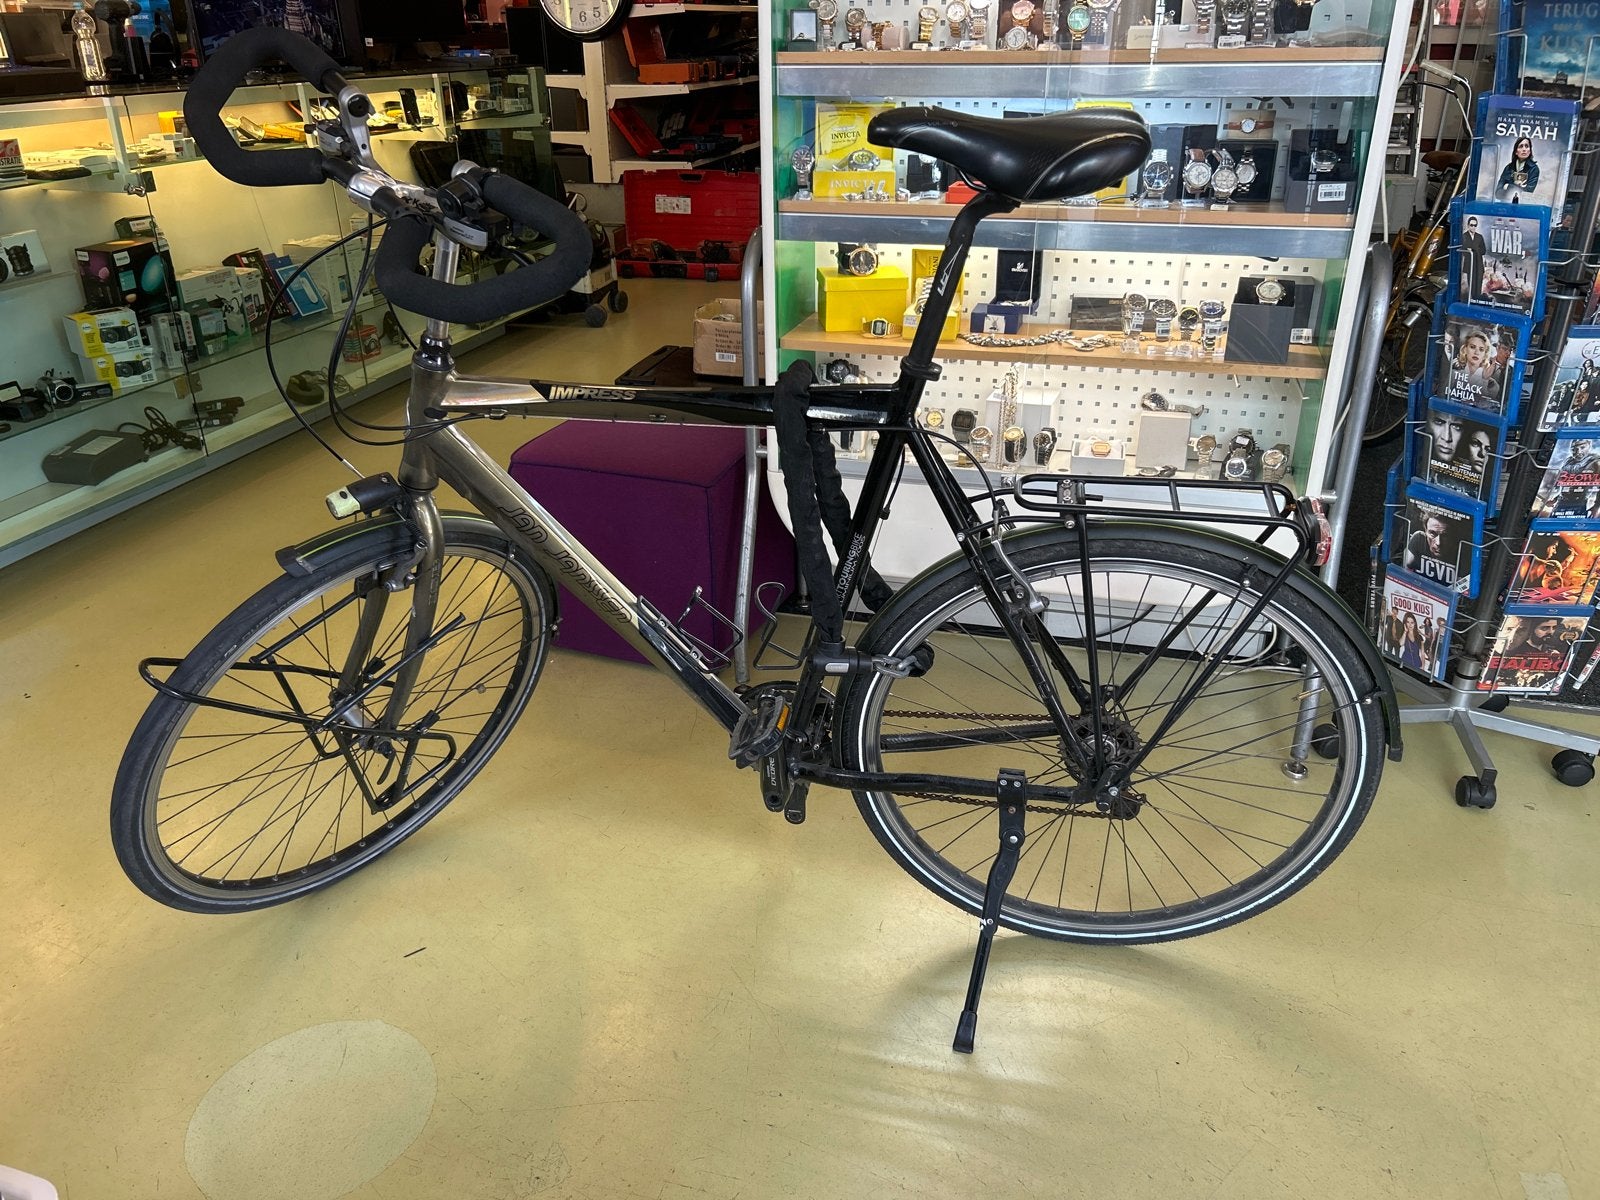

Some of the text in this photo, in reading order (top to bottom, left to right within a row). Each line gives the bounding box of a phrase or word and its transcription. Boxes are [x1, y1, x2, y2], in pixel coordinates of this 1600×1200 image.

[579, 11, 587, 22] 6
[593, 6, 601, 18] 5
[1543, 2, 1599, 18] TERUG
[831, 131, 861, 140] INVICTA
[1496, 122, 1558, 141] SARAH
[1490, 227, 1526, 260] WAR,
[1454, 371, 1469, 383] THE
[549, 386, 637, 400] IMPRESS
[1444, 386, 1475, 402] DAHLIA
[1456, 380, 1483, 395] BLACK
[1416, 557, 1457, 585] JCVD
[1393, 598, 1431, 615] GOOD KIDS
